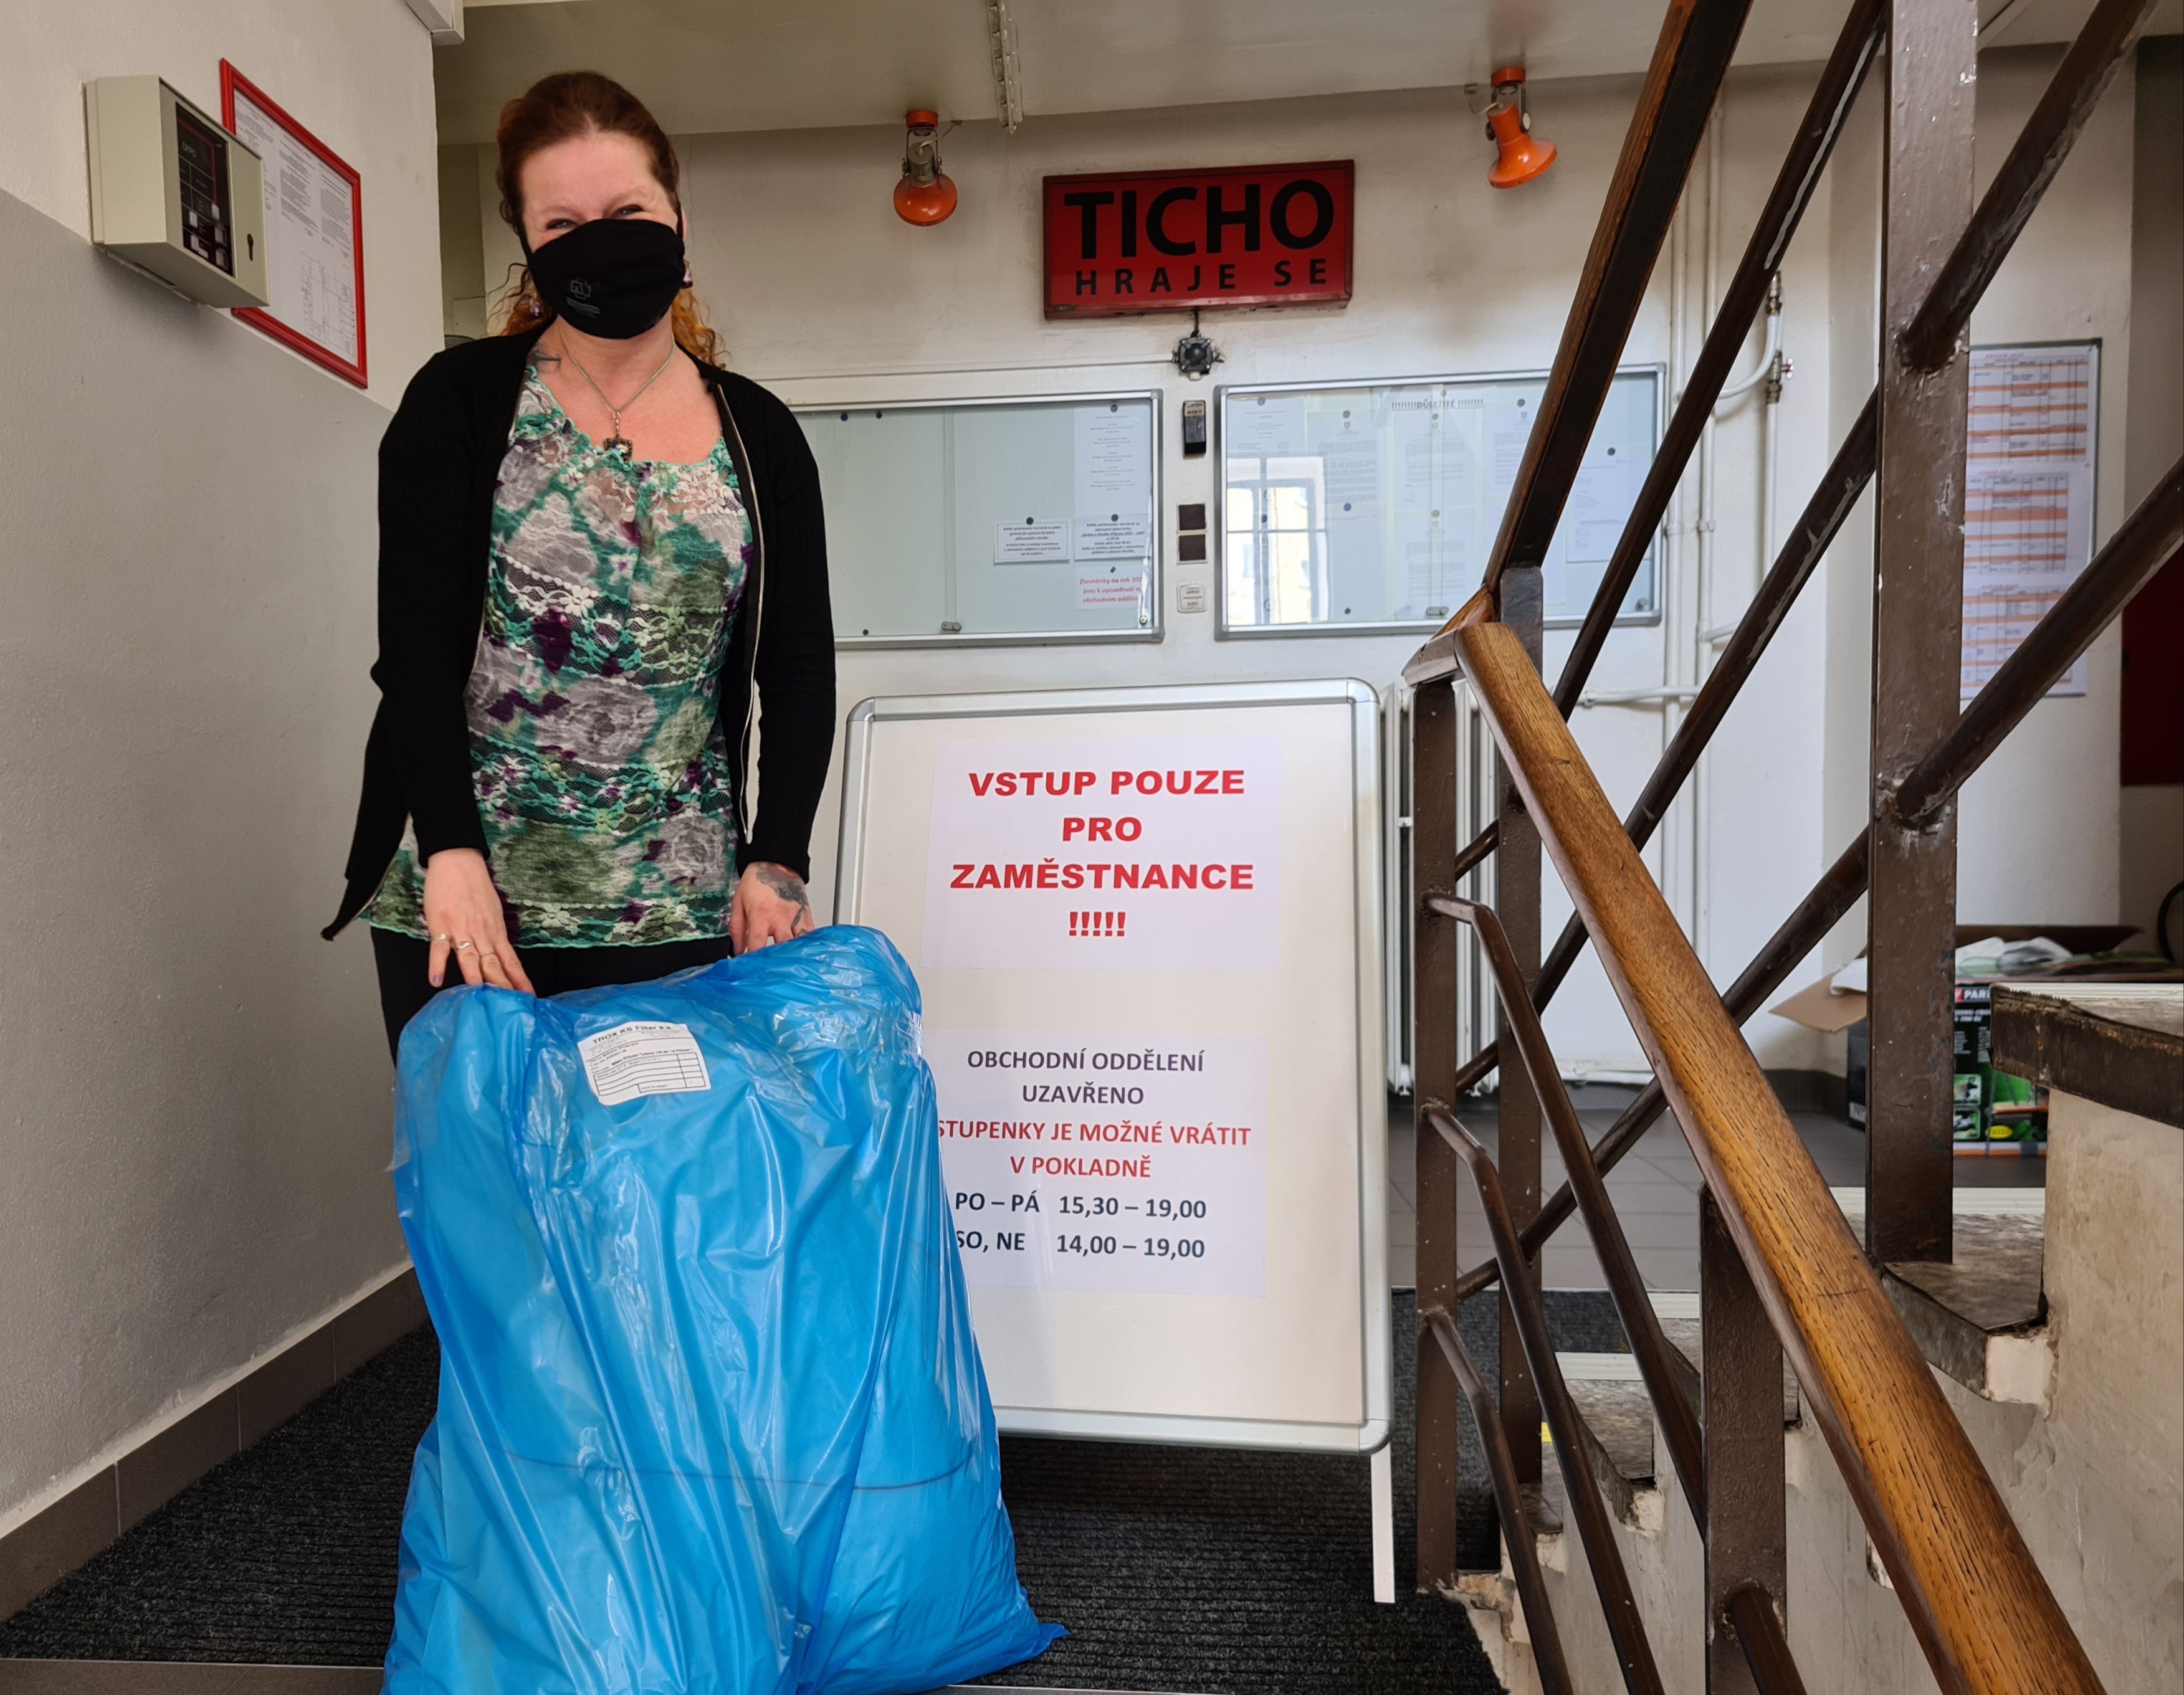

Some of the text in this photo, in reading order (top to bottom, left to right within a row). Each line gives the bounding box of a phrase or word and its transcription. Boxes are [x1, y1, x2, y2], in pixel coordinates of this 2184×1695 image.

[1064, 179, 1334, 259] TICHO
[1075, 259, 1326, 295] HRAJE SE
[969, 770, 1245, 796] VSTUP POUZE
[1062, 817, 1142, 842] PRO
[950, 858, 1254, 890] ZAMĚSTNANCE
[1069, 911, 1126, 936] !!!!!
[968, 1047, 1205, 1071] OBCHODNÍ ODDĚLENÍ
[1023, 1082, 1144, 1104] UZAVŘENO
[1052, 1123, 1072, 1141] JE
[1080, 1120, 1163, 1143] MOŽNÉ
[1170, 1122, 1251, 1145] VRÁTIT
[1011, 1156, 1151, 1178] V POKLADNĚ
[956, 1192, 985, 1210] PO
[1011, 1190, 1039, 1213] PÁ
[1059, 1195, 1118, 1218] 15,30
[1146, 1199, 1206, 1222] 19,00
[956, 1230, 989, 1253] SO,
[997, 1232, 1025, 1251] NE
[1057, 1235, 1116, 1257] 14,00
[1143, 1238, 1204, 1260] 19,00
